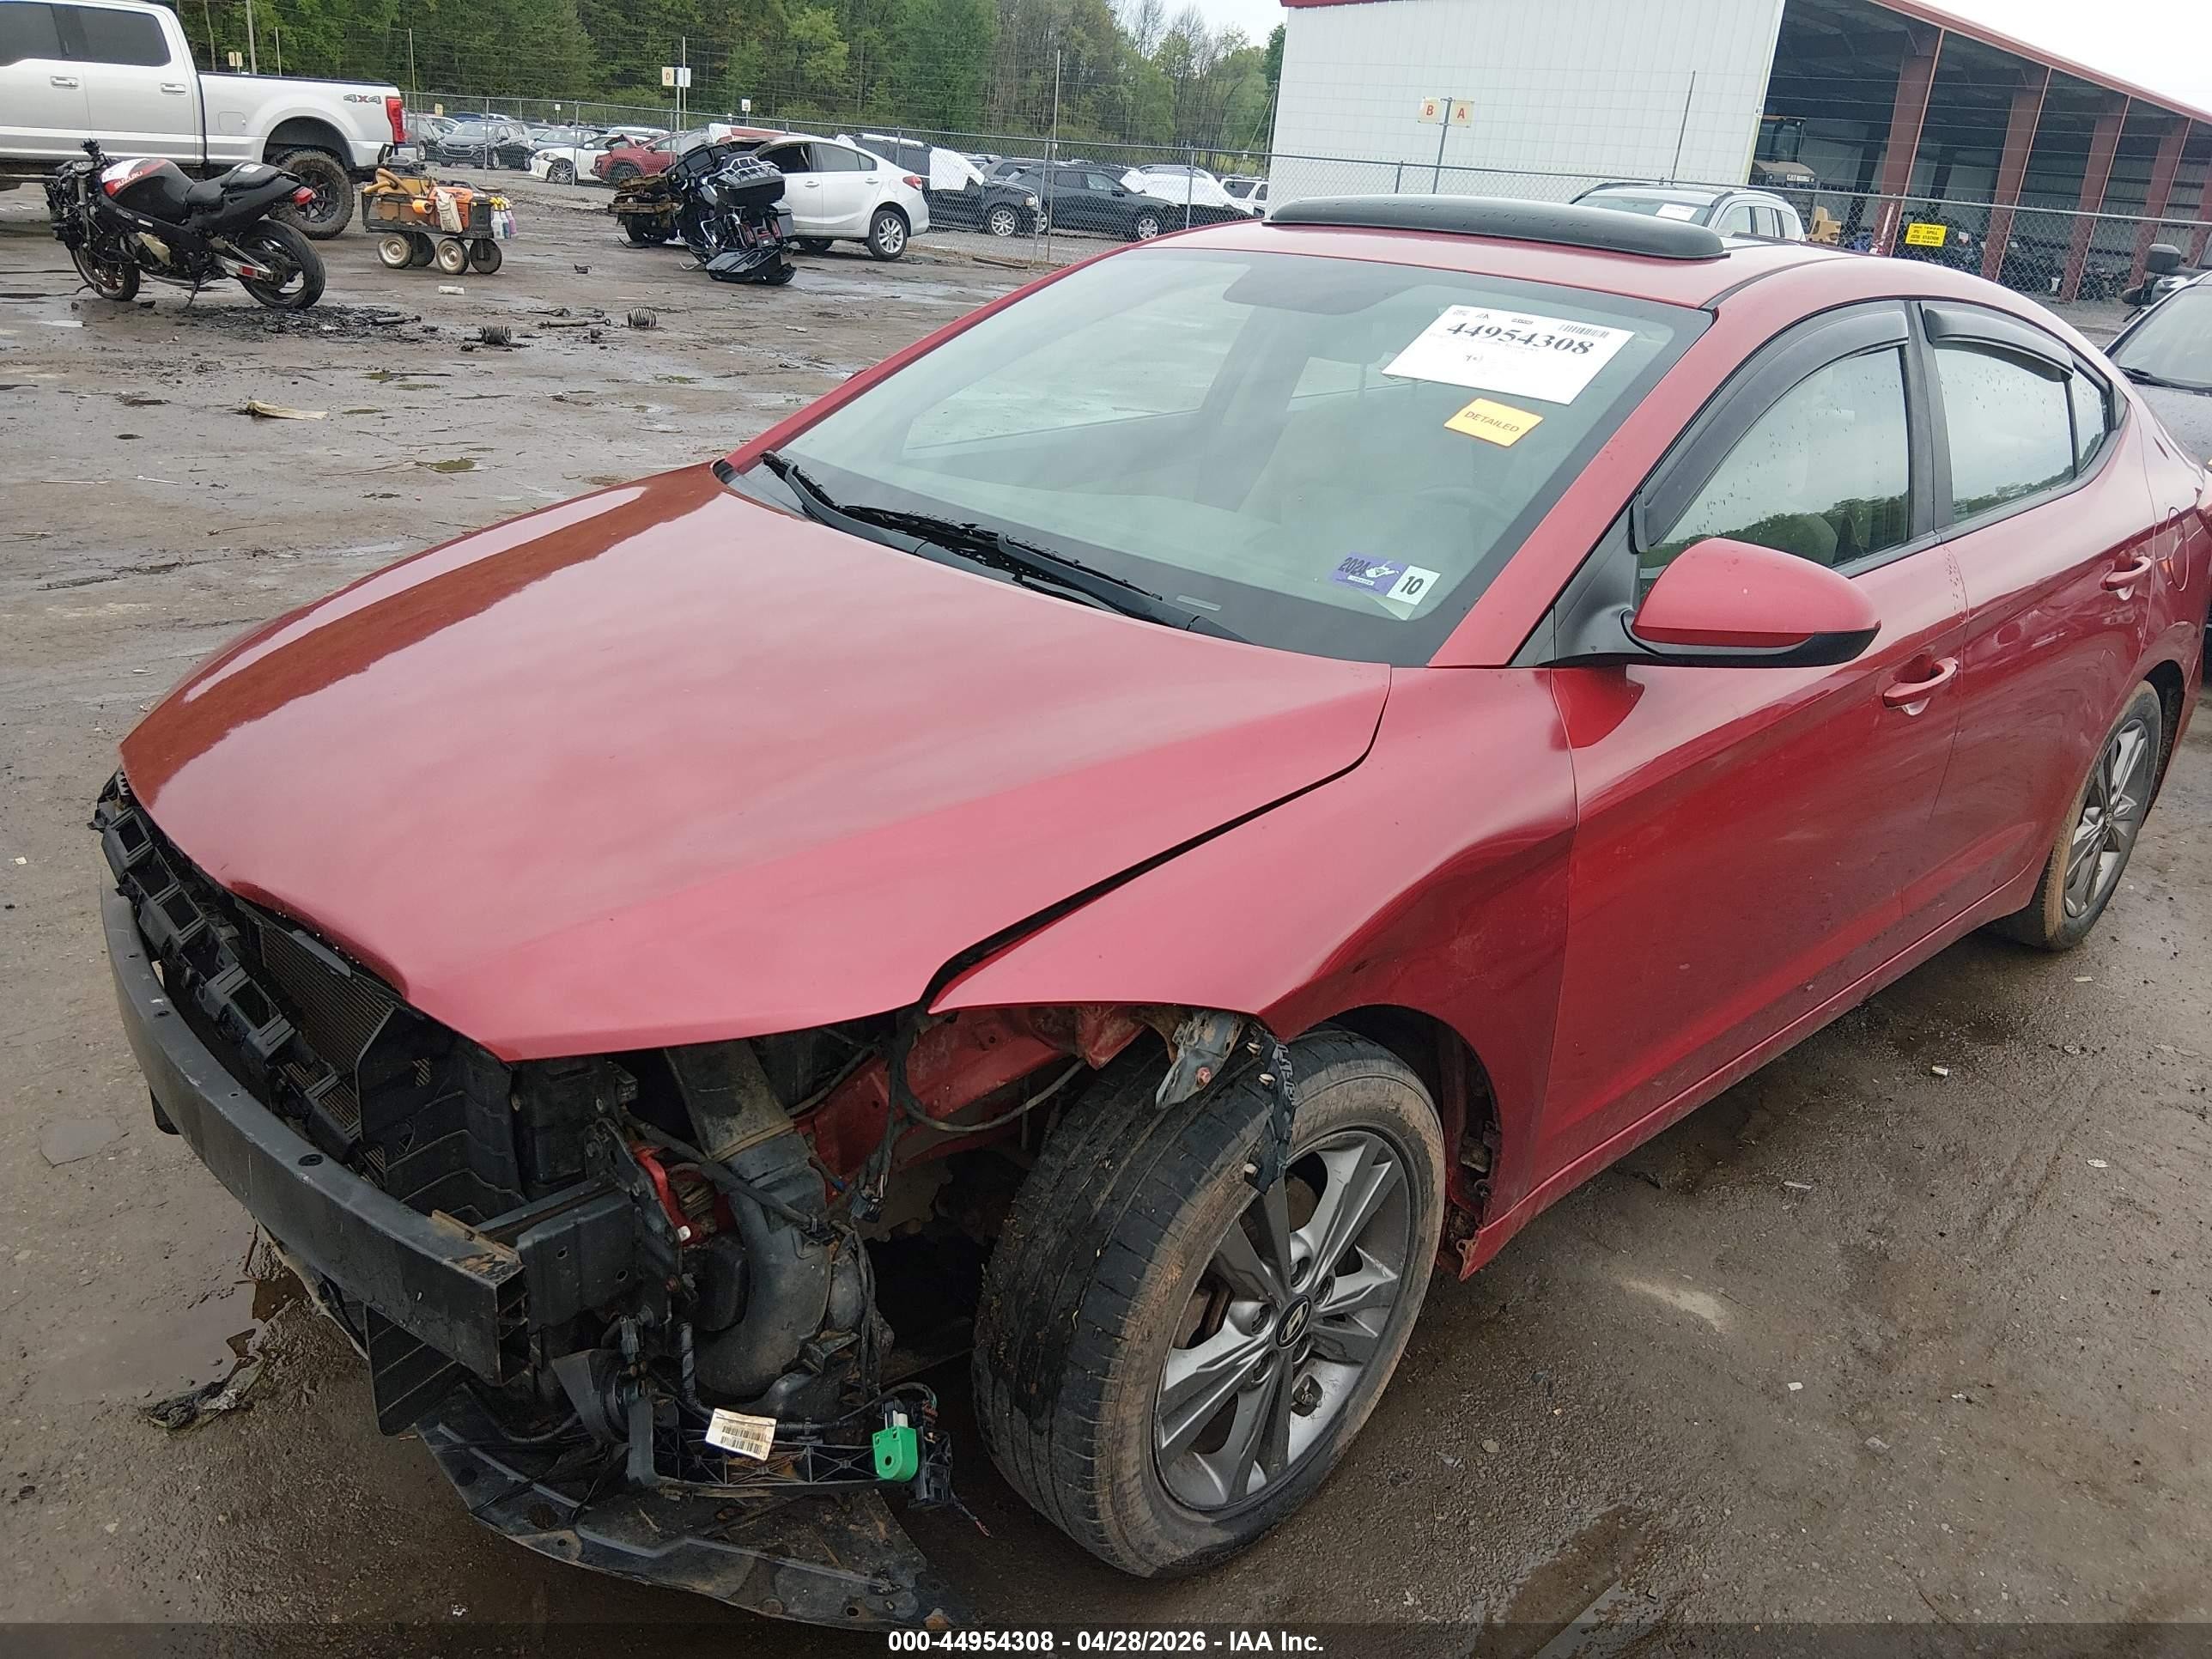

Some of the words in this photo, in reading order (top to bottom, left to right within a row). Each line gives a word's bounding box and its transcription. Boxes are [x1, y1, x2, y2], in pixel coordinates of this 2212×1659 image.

[1426, 105, 1434, 116] B
[1457, 107, 1465, 118] A
[1446, 322, 1595, 355] 44954308
[1463, 410, 1520, 434] DETAILED
[1338, 556, 1372, 577] 2024
[1400, 576, 1425, 595] 10
